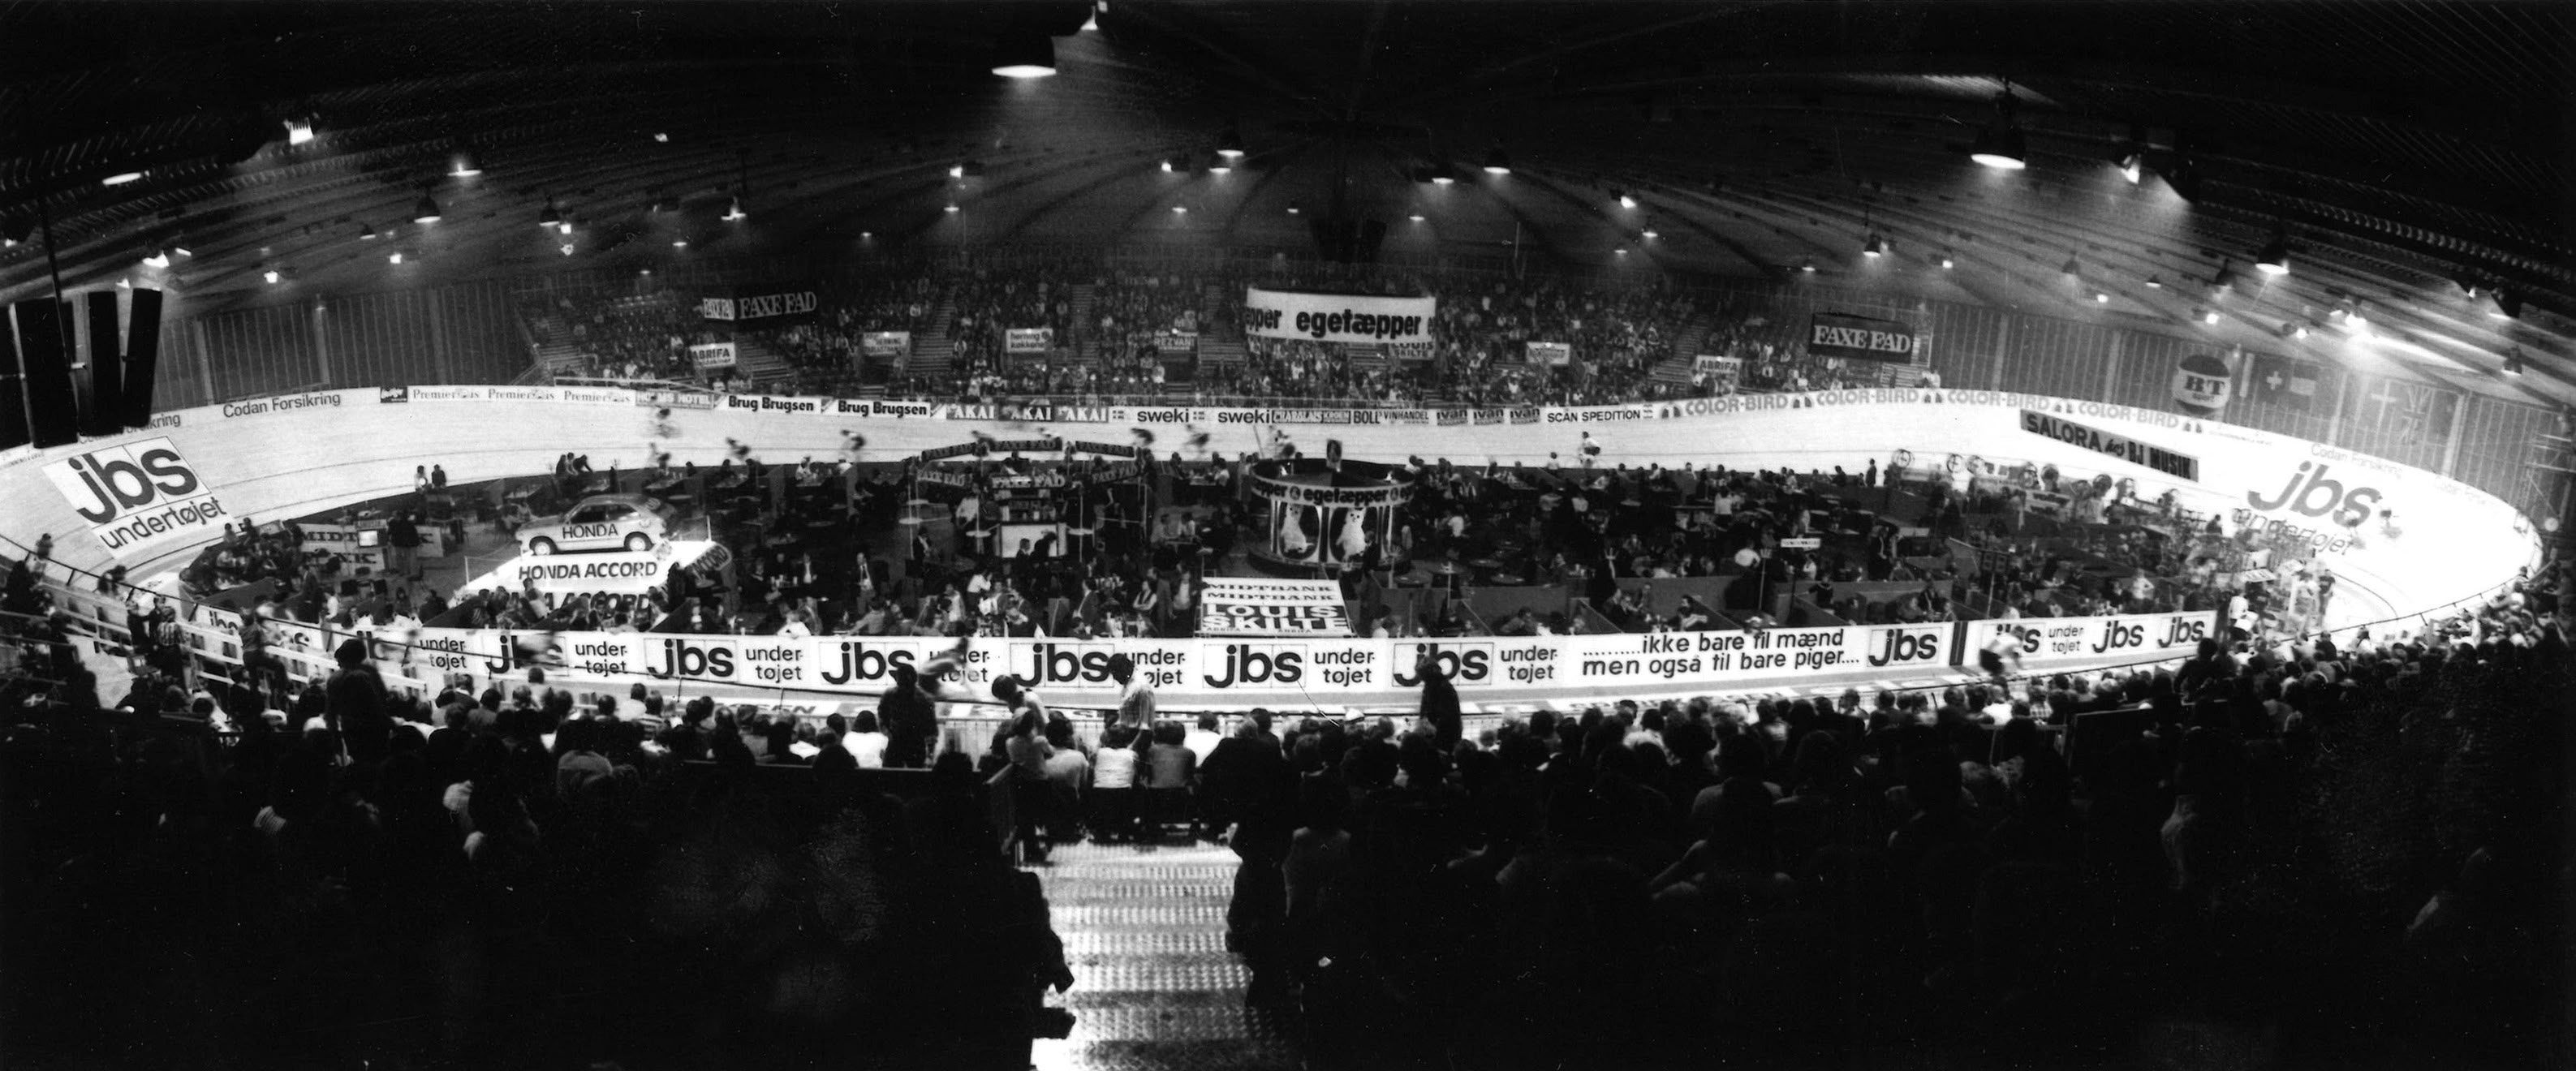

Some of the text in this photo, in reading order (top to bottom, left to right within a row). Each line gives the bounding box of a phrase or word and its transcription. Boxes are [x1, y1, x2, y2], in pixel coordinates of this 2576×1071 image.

[739, 291, 817, 319] FAXE FAD
[1296, 308, 1421, 339] egetæpper
[1812, 325, 1911, 353] FAXE FAD
[412, 389, 455, 399] Premier
[488, 388, 531, 399] Premier
[564, 389, 607, 402] Premier
[1816, 388, 1919, 406] COLOR-BIRD
[1947, 390, 2050, 411] COLOR-BIRD
[223, 393, 341, 418] Codan Forsikring
[728, 395, 814, 413] Brug Brugsen
[838, 400, 927, 419] Brug Brugsen
[954, 405, 995, 419] AKAI
[1010, 406, 1052, 420] AKAI
[1065, 406, 1107, 421] AKAI
[1685, 395, 1786, 415] COLOR-BIRD
[2078, 399, 2179, 429] COLOR-BIRD
[1137, 408, 1189, 423] sweki
[1217, 409, 1270, 424] sweki
[1547, 411, 1578, 423] SCAN
[1582, 410, 1640, 422] SPEDITION
[2025, 413, 2103, 454] SALORA
[2149, 447, 2191, 480] MUSIK
[68, 449, 197, 523] jbs
[2246, 460, 2383, 527] jbs
[100, 497, 227, 550] undertøjet
[562, 523, 618, 540] HONDA
[519, 561, 657, 581] HONDA ACCORD
[1206, 604, 1338, 617] LOUIS
[1203, 617, 1350, 630] SKILTE
[2157, 616, 2206, 648] jbs
[1699, 632, 1745, 652] bare
[1754, 630, 1771, 649] til
[1777, 629, 1844, 648] mænd
[2092, 620, 2145, 653] jbs
[1867, 629, 1938, 667] jbs
[429, 653, 467, 671] tøjet
[647, 638, 734, 680] jbs
[821, 642, 915, 685] jbs
[1011, 643, 1111, 687] jbs
[1204, 644, 1303, 688] jbs
[1394, 643, 1488, 687] jbs
[1583, 659, 1639, 676] men
[1649, 654, 1701, 679] også
[1712, 652, 1730, 671] til
[1740, 652, 1786, 670] bare
[585, 660, 627, 679] tøjet
[756, 665, 803, 683] tøjet
[1323, 667, 1372, 687] tøjet
[1508, 664, 1554, 684] tøjet
